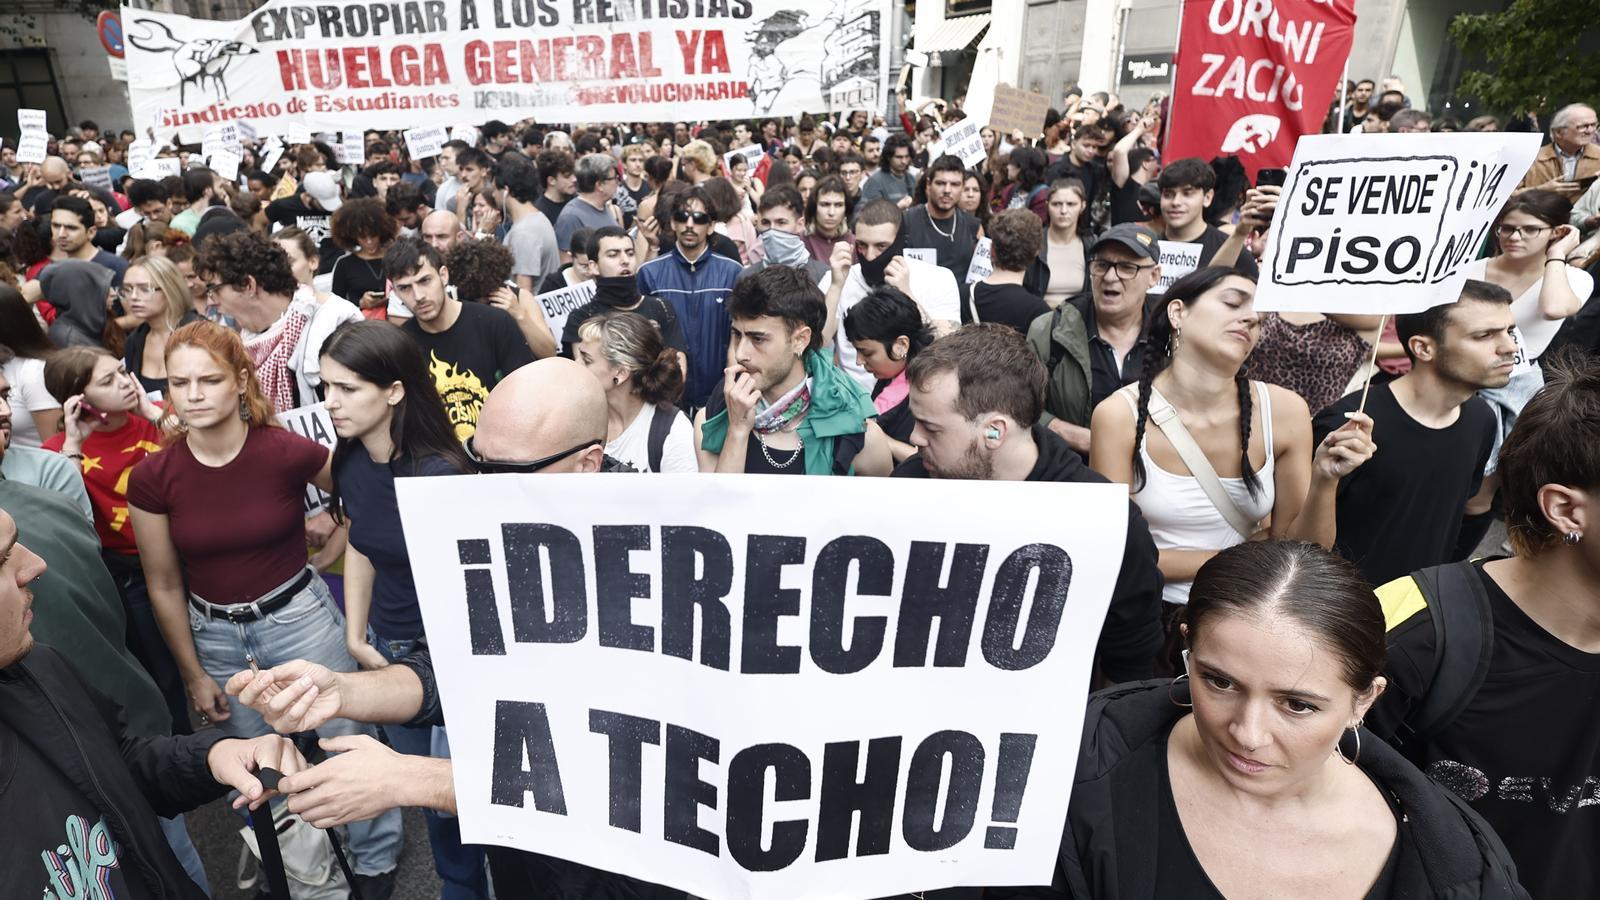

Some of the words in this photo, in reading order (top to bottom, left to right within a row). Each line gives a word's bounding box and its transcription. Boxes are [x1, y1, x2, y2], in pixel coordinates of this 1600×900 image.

[252, 1, 447, 42] EXPROPIAR
[460, 0, 480, 30] A
[495, 0, 559, 29] LOS
[277, 43, 450, 91] HUELGA
[464, 31, 661, 85] GENERAL
[675, 29, 732, 74] YA
[162, 102, 282, 127] Sindicato
[287, 96, 307, 113] de
[314, 91, 460, 112] Estudiantes
[1301, 176, 1340, 216] SE
[1347, 173, 1438, 215] VENDE
[1160, 250, 1198, 267] erechos
[457, 522, 1074, 675] ¡DERECHO
[491, 699, 568, 817] A
[589, 707, 1039, 873] TECHO!
